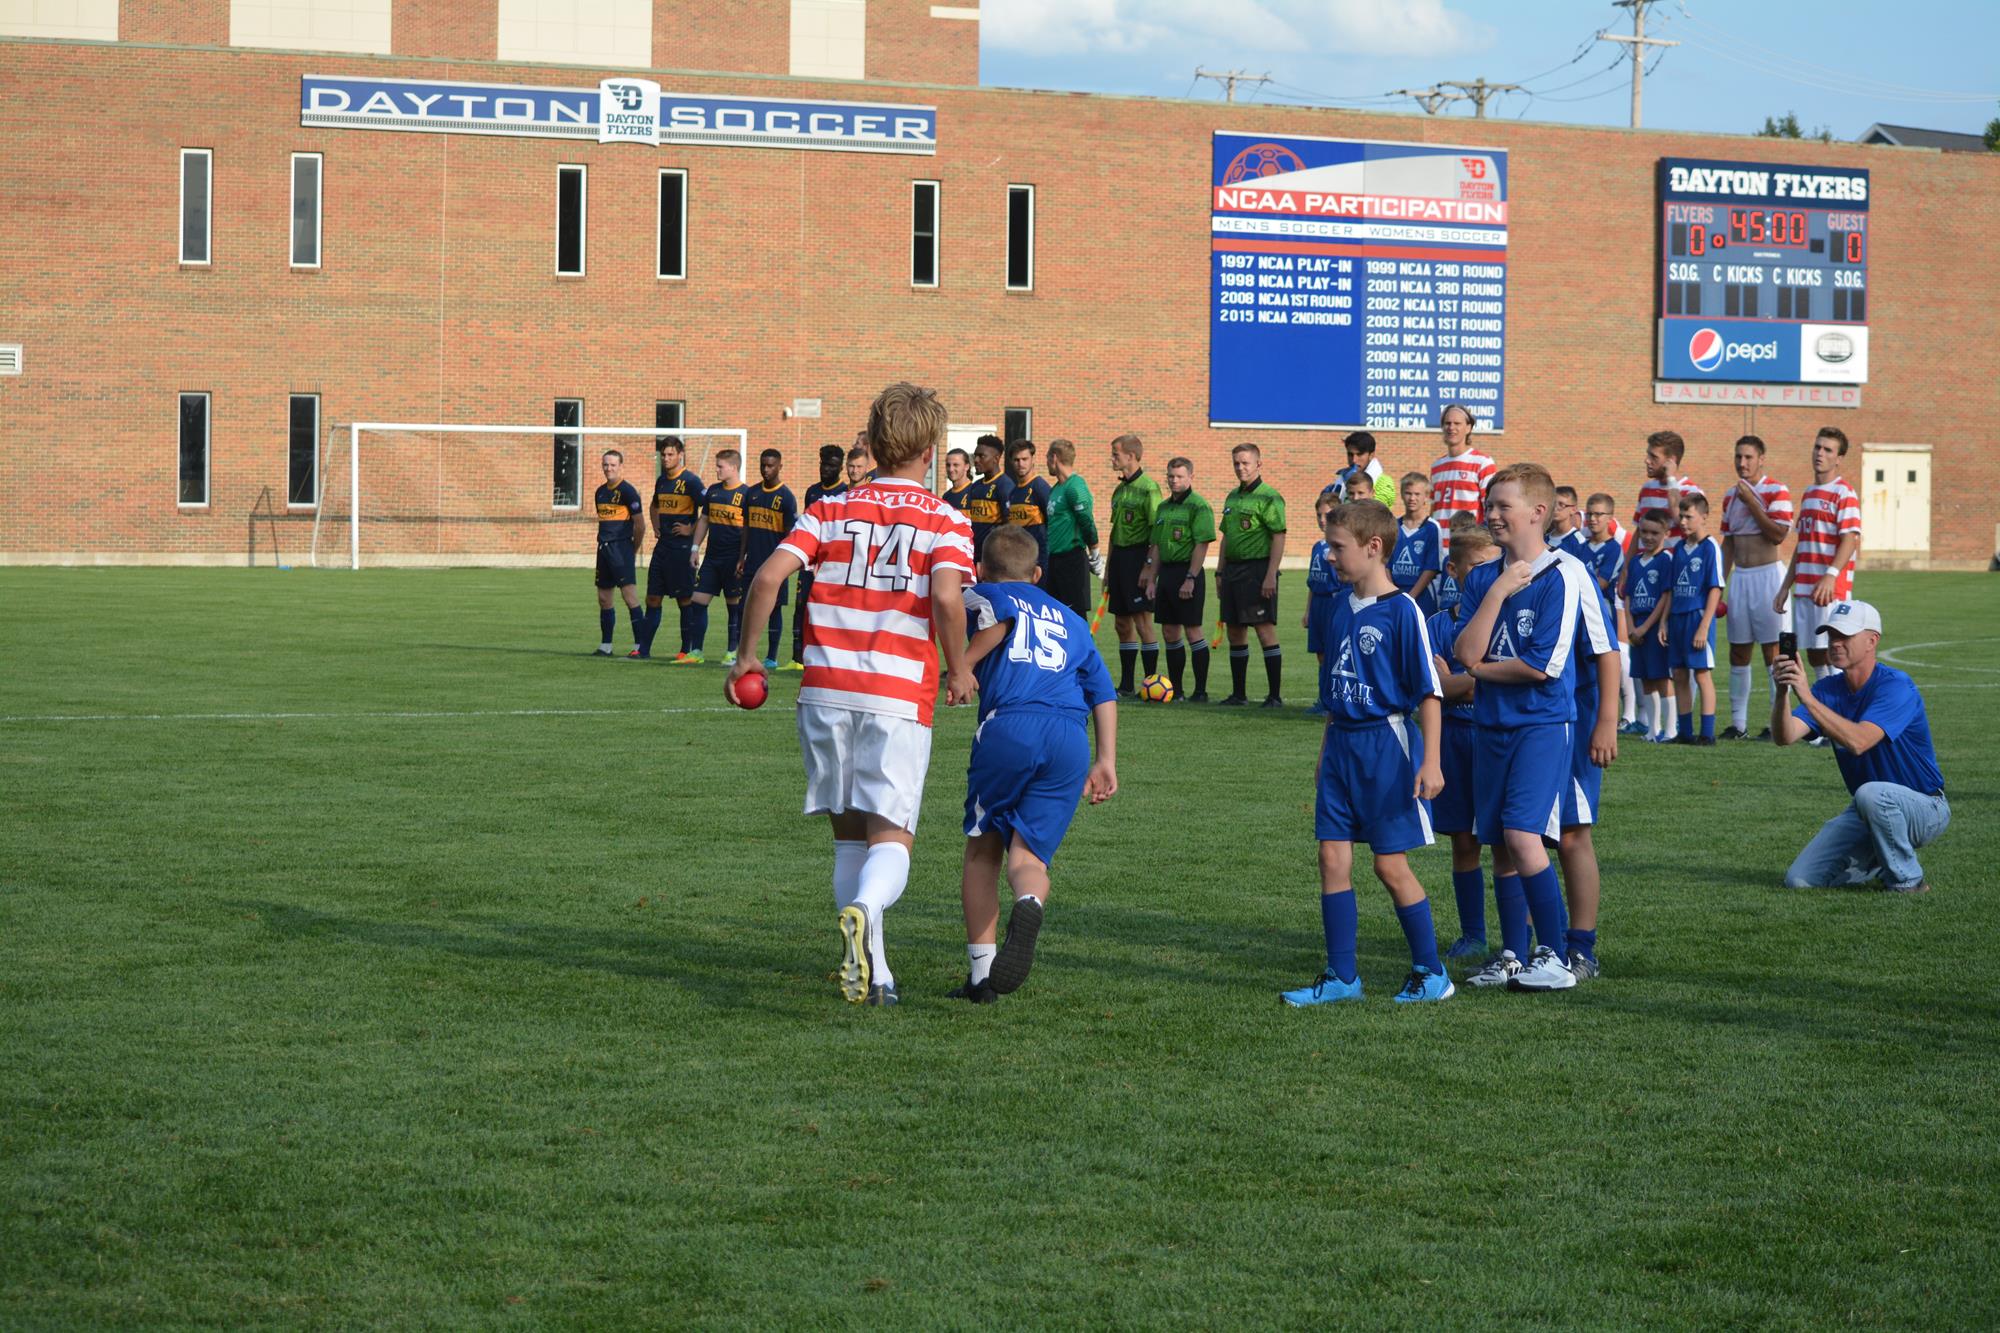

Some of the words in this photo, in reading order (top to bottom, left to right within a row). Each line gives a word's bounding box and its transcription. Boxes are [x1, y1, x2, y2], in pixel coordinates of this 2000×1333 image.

[308, 87, 590, 123] DAYTON
[670, 106, 930, 140] SOCCER
[607, 113, 654, 125] DAYTON
[608, 125, 653, 136] FLYERS
[1669, 167, 1769, 196] DAYTON
[1773, 173, 1867, 201] FLYERS
[1218, 190, 1296, 211] NCAA
[1305, 194, 1503, 222] PARTICIPATION
[1667, 205, 1713, 223] FLYERS
[1219, 220, 1270, 232] MENS
[1280, 223, 1353, 235] SOCCER
[1731, 211, 1804, 243] 45:00
[1827, 213, 1865, 231] GUEST
[1369, 227, 1435, 239] WOMENS
[1441, 230, 1501, 242] SOCCER
[1689, 225, 1705, 255] 0
[1847, 232, 1862, 263] 0
[1220, 255, 1254, 269] 1997
[1258, 256, 1293, 270] NCAA
[1298, 258, 1352, 273] PLAY-IN
[1367, 261, 1396, 274] 1999
[1400, 262, 1431, 276] NCAA
[1435, 264, 1459, 277] 2ND
[1463, 265, 1503, 279] ROUND
[1669, 263, 1699, 281] S.O.G.
[1220, 273, 1255, 287] 1998
[1258, 275, 1293, 289] NCAA
[1298, 276, 1352, 291] PLAY-IN
[1713, 265, 1722, 283] C
[1727, 266, 1763, 284] KICKS
[1773, 267, 1781, 285] C
[1787, 268, 1822, 286] KICKS
[1834, 271, 1864, 288] S.O.G.
[1367, 279, 1397, 293] 2001
[1400, 281, 1431, 294] NCAA
[1435, 282, 1459, 295] 3RD
[1463, 283, 1503, 297] ROUND
[1220, 291, 1254, 305] 2008
[1258, 293, 1290, 306] NCAA
[1291, 294, 1308, 307] 1ST
[1310, 295, 1352, 308] ROUND
[1367, 297, 1400, 310] 2002
[1404, 298, 1435, 312] NCAA
[1438, 300, 1458, 312] 1ST
[1461, 301, 1502, 314] ROUND
[1220, 309, 1254, 322] 2015
[1258, 311, 1288, 324] NCAA
[1366, 315, 1399, 328] 2003
[1403, 316, 1435, 329] NCAA
[1438, 317, 1458, 330] 1ST
[1461, 318, 1502, 332] ROUND
[1366, 333, 1399, 345] 2004
[1403, 334, 1434, 347] NCAA
[1438, 335, 1457, 348] 1ST
[1461, 336, 1502, 349] ROUND
[1366, 350, 1398, 363] 2009
[1400, 351, 1430, 364] NCAA
[1437, 353, 1461, 365] 2ND
[1462, 354, 1501, 367] ROUND
[1726, 341, 1778, 362] pepsi
[1366, 368, 1396, 380] 2010
[1400, 369, 1429, 381] NCAA
[1437, 370, 1459, 382] 2ND
[1462, 371, 1500, 383] ROUND
[1366, 385, 1396, 397] 2011
[1399, 386, 1430, 398] NCAA
[1438, 387, 1456, 399] 1ST
[1459, 388, 1498, 400] ROUND
[1661, 384, 1768, 400] BAUJAN
[1783, 387, 1856, 402] FIELD
[1366, 402, 1395, 414] 2014
[1399, 403, 1428, 415] NCAA
[1465, 405, 1495, 417] OUND
[1366, 416, 1396, 428] 2016
[1398, 417, 1426, 429] NCAA
[1473, 419, 1494, 430] UND
[674, 480, 686, 494] 24
[772, 495, 782, 510] 15
[846, 488, 942, 514] DAYTON
[961, 494, 968, 508] 4
[751, 512, 773, 523] ETSU
[844, 520, 918, 591] 14
[1008, 611, 1068, 673] 15
